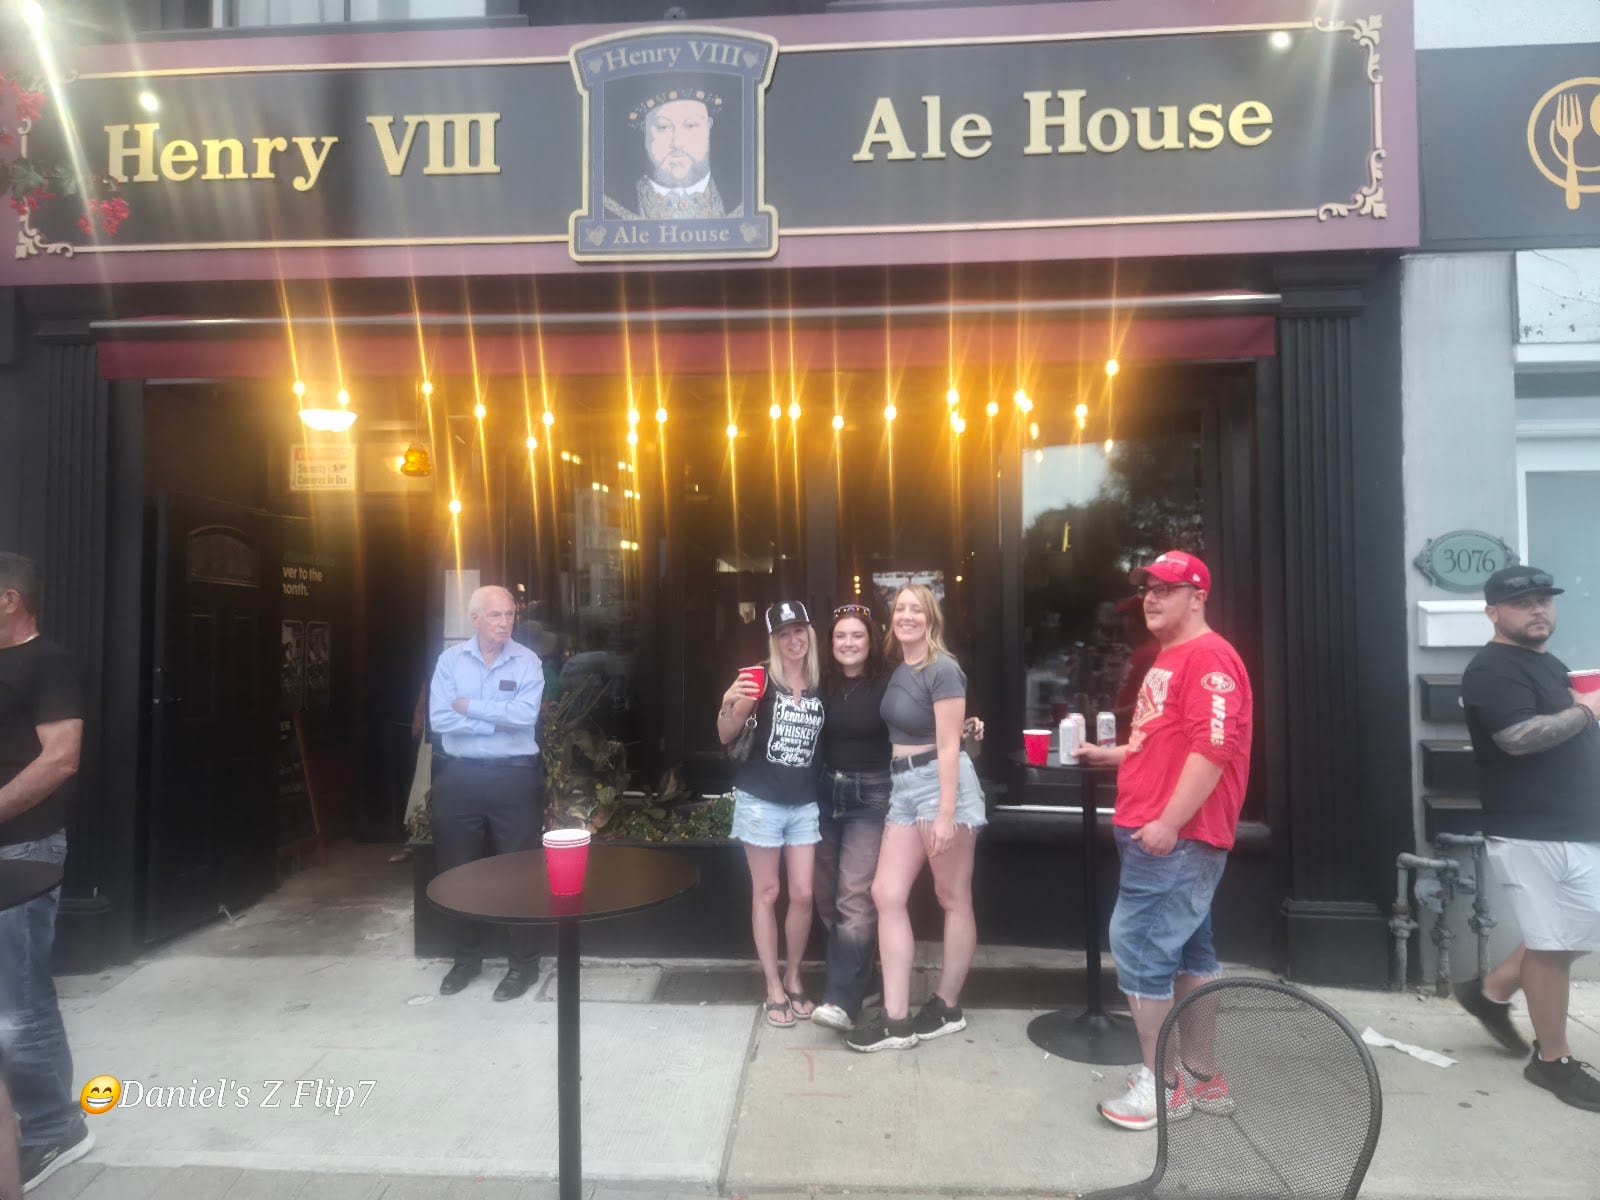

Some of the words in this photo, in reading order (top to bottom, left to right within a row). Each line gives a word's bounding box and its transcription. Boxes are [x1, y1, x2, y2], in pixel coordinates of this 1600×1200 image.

[604, 47, 681, 71] Henry
[688, 41, 744, 67] VIII
[852, 95, 993, 162] Ale
[1023, 89, 1274, 155] House
[104, 122, 339, 192] Henry
[366, 112, 502, 176] VIII
[613, 225, 649, 244] Ale
[660, 225, 730, 243] House
[1443, 549, 1496, 573] 3076
[298, 567, 308, 580] to
[309, 567, 323, 582] the
[776, 723, 818, 741] WHISKEY
